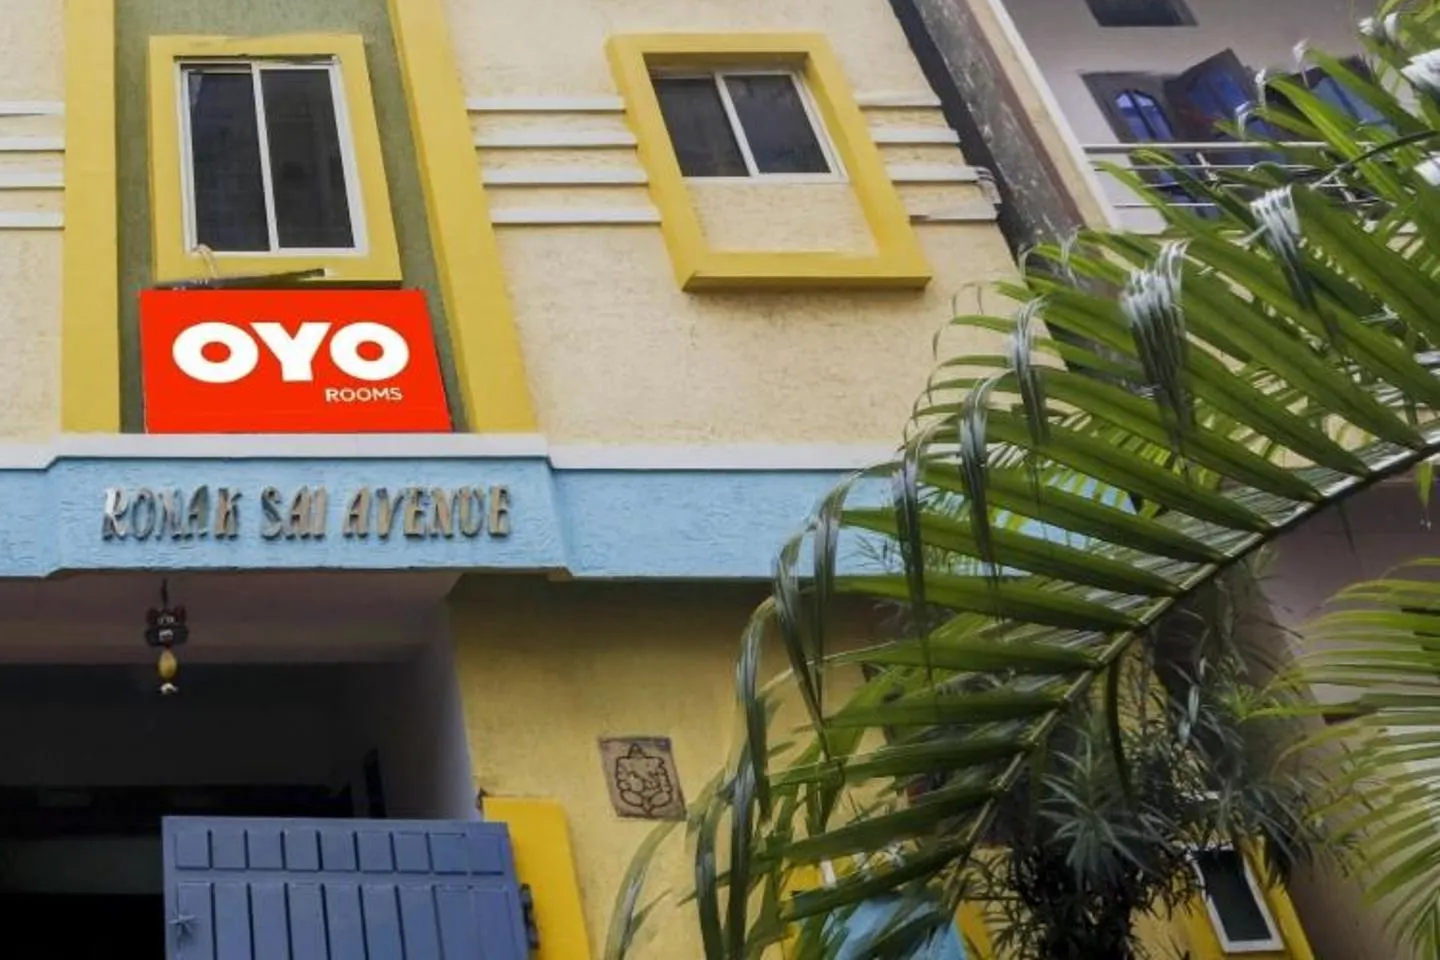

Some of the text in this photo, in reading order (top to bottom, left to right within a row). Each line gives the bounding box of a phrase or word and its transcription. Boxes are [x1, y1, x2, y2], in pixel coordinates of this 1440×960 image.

[172, 320, 410, 384] OYO
[325, 386, 404, 402] ROOMS
[260, 484, 327, 541] SAI
[340, 484, 514, 540] AVENUE
